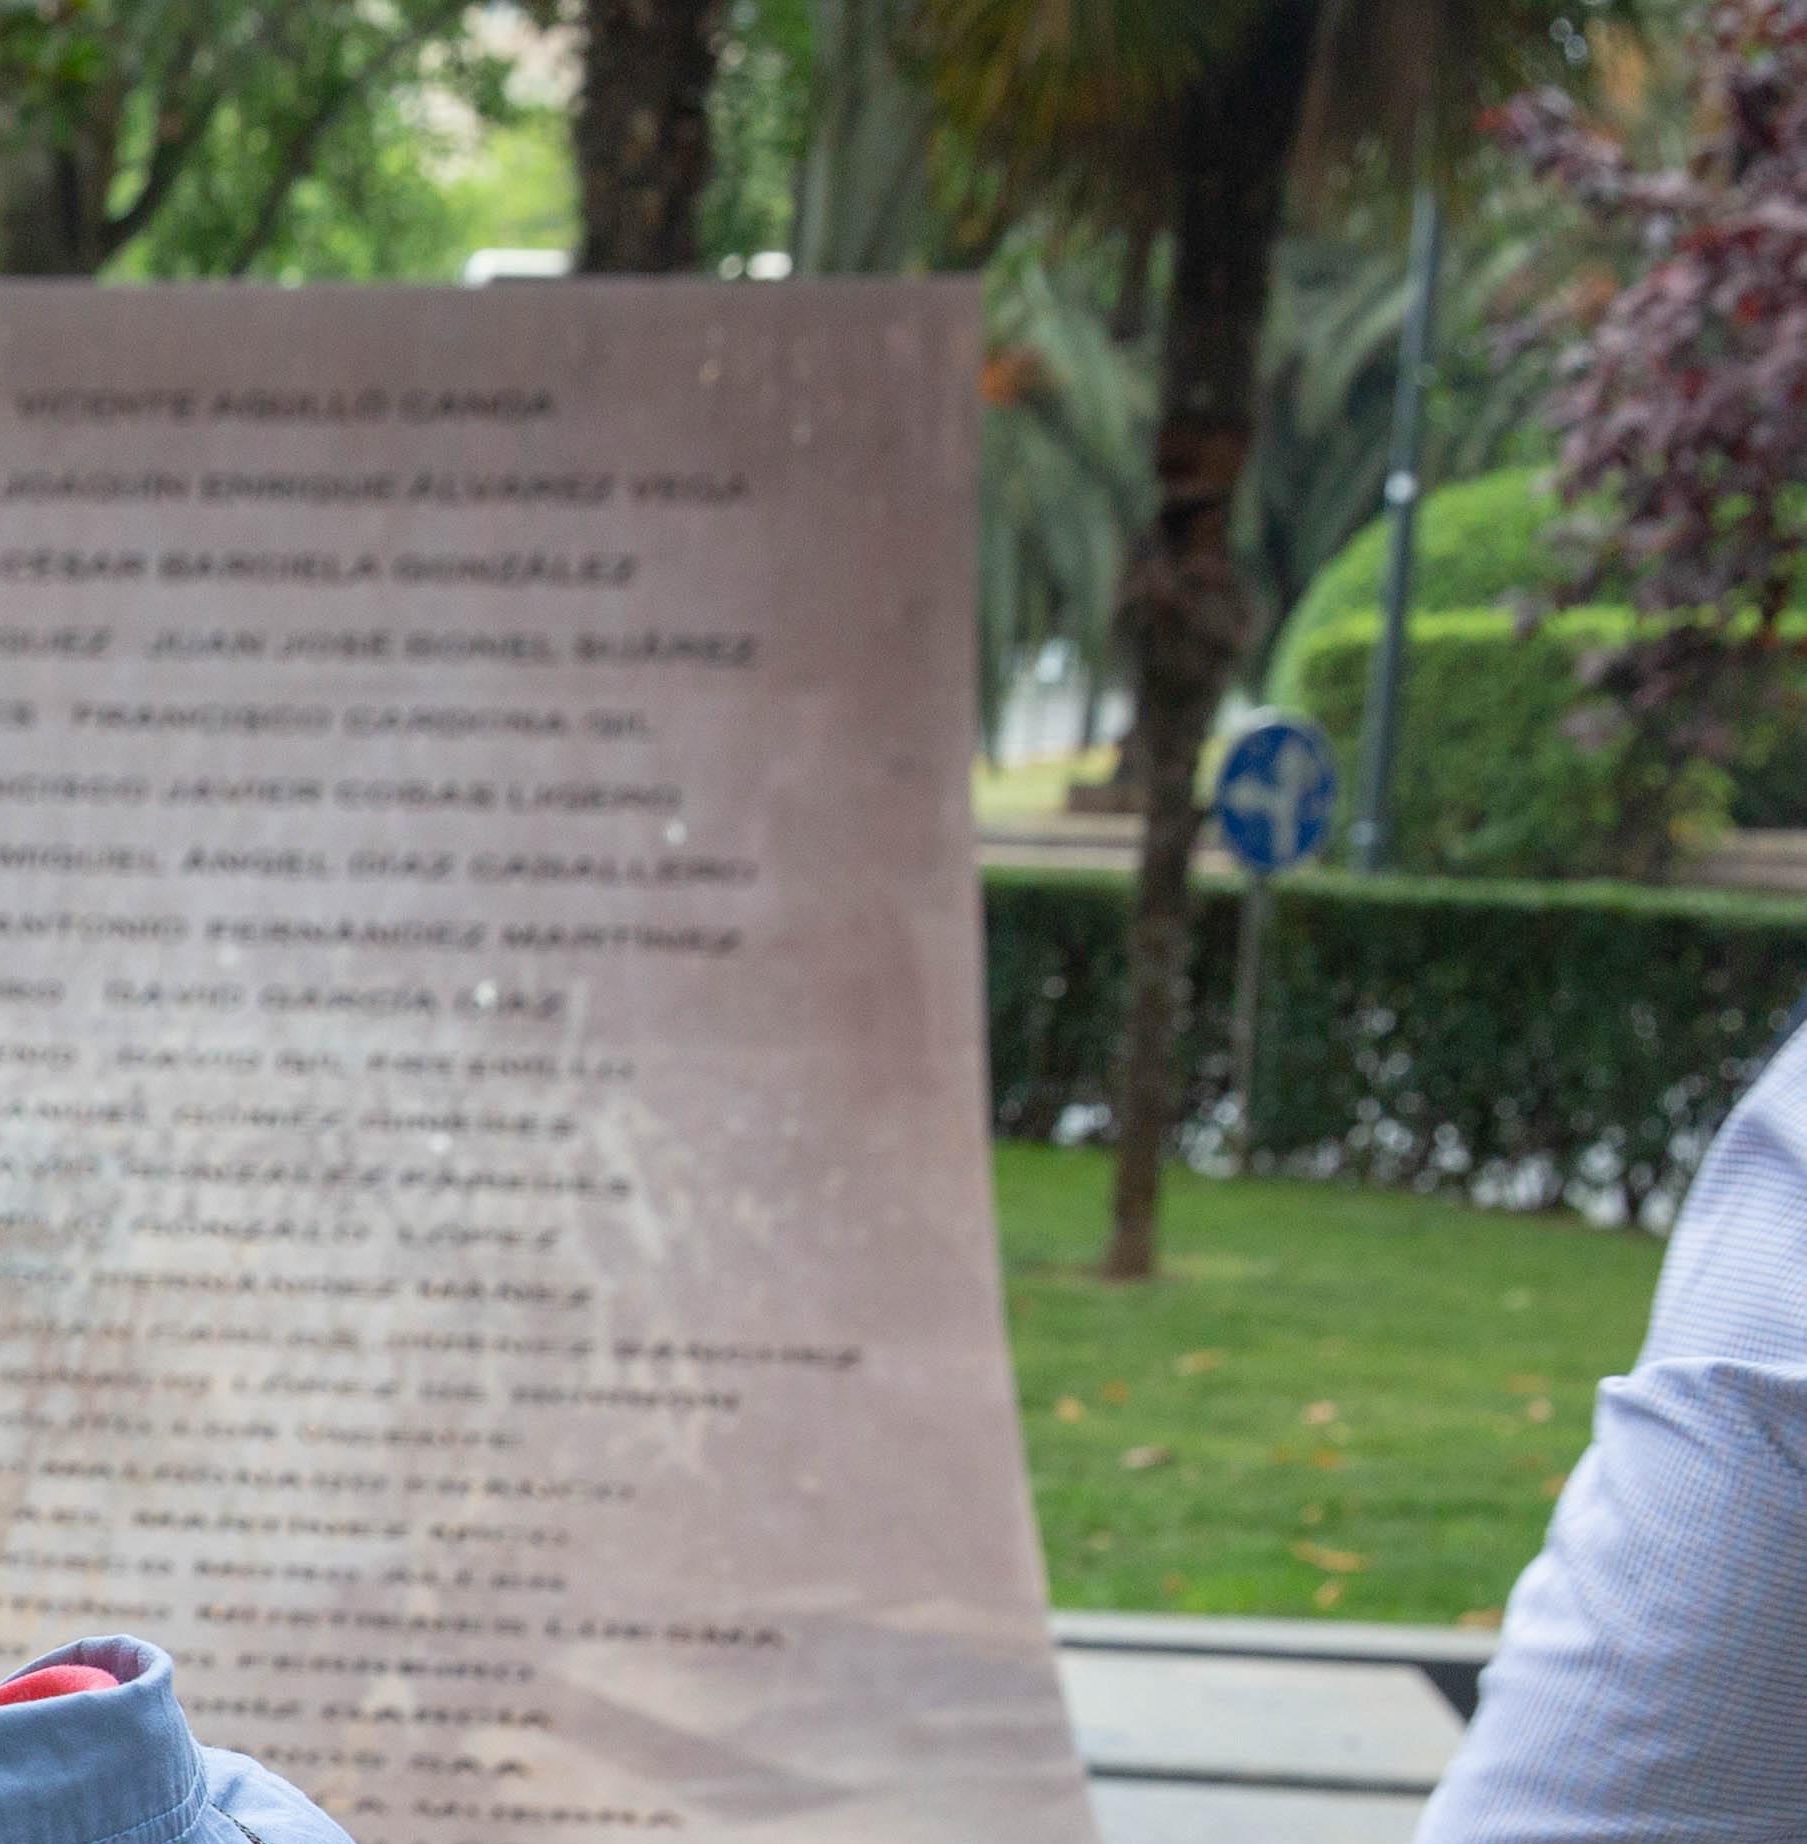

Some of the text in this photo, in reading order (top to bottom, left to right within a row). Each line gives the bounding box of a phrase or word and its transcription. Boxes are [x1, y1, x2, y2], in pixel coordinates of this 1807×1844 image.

[203, 470, 397, 506] ENRIQUE
[148, 626, 263, 660] JUAN
[72, 699, 329, 735] FRANCISCO
[164, 775, 322, 809] JAVIER
